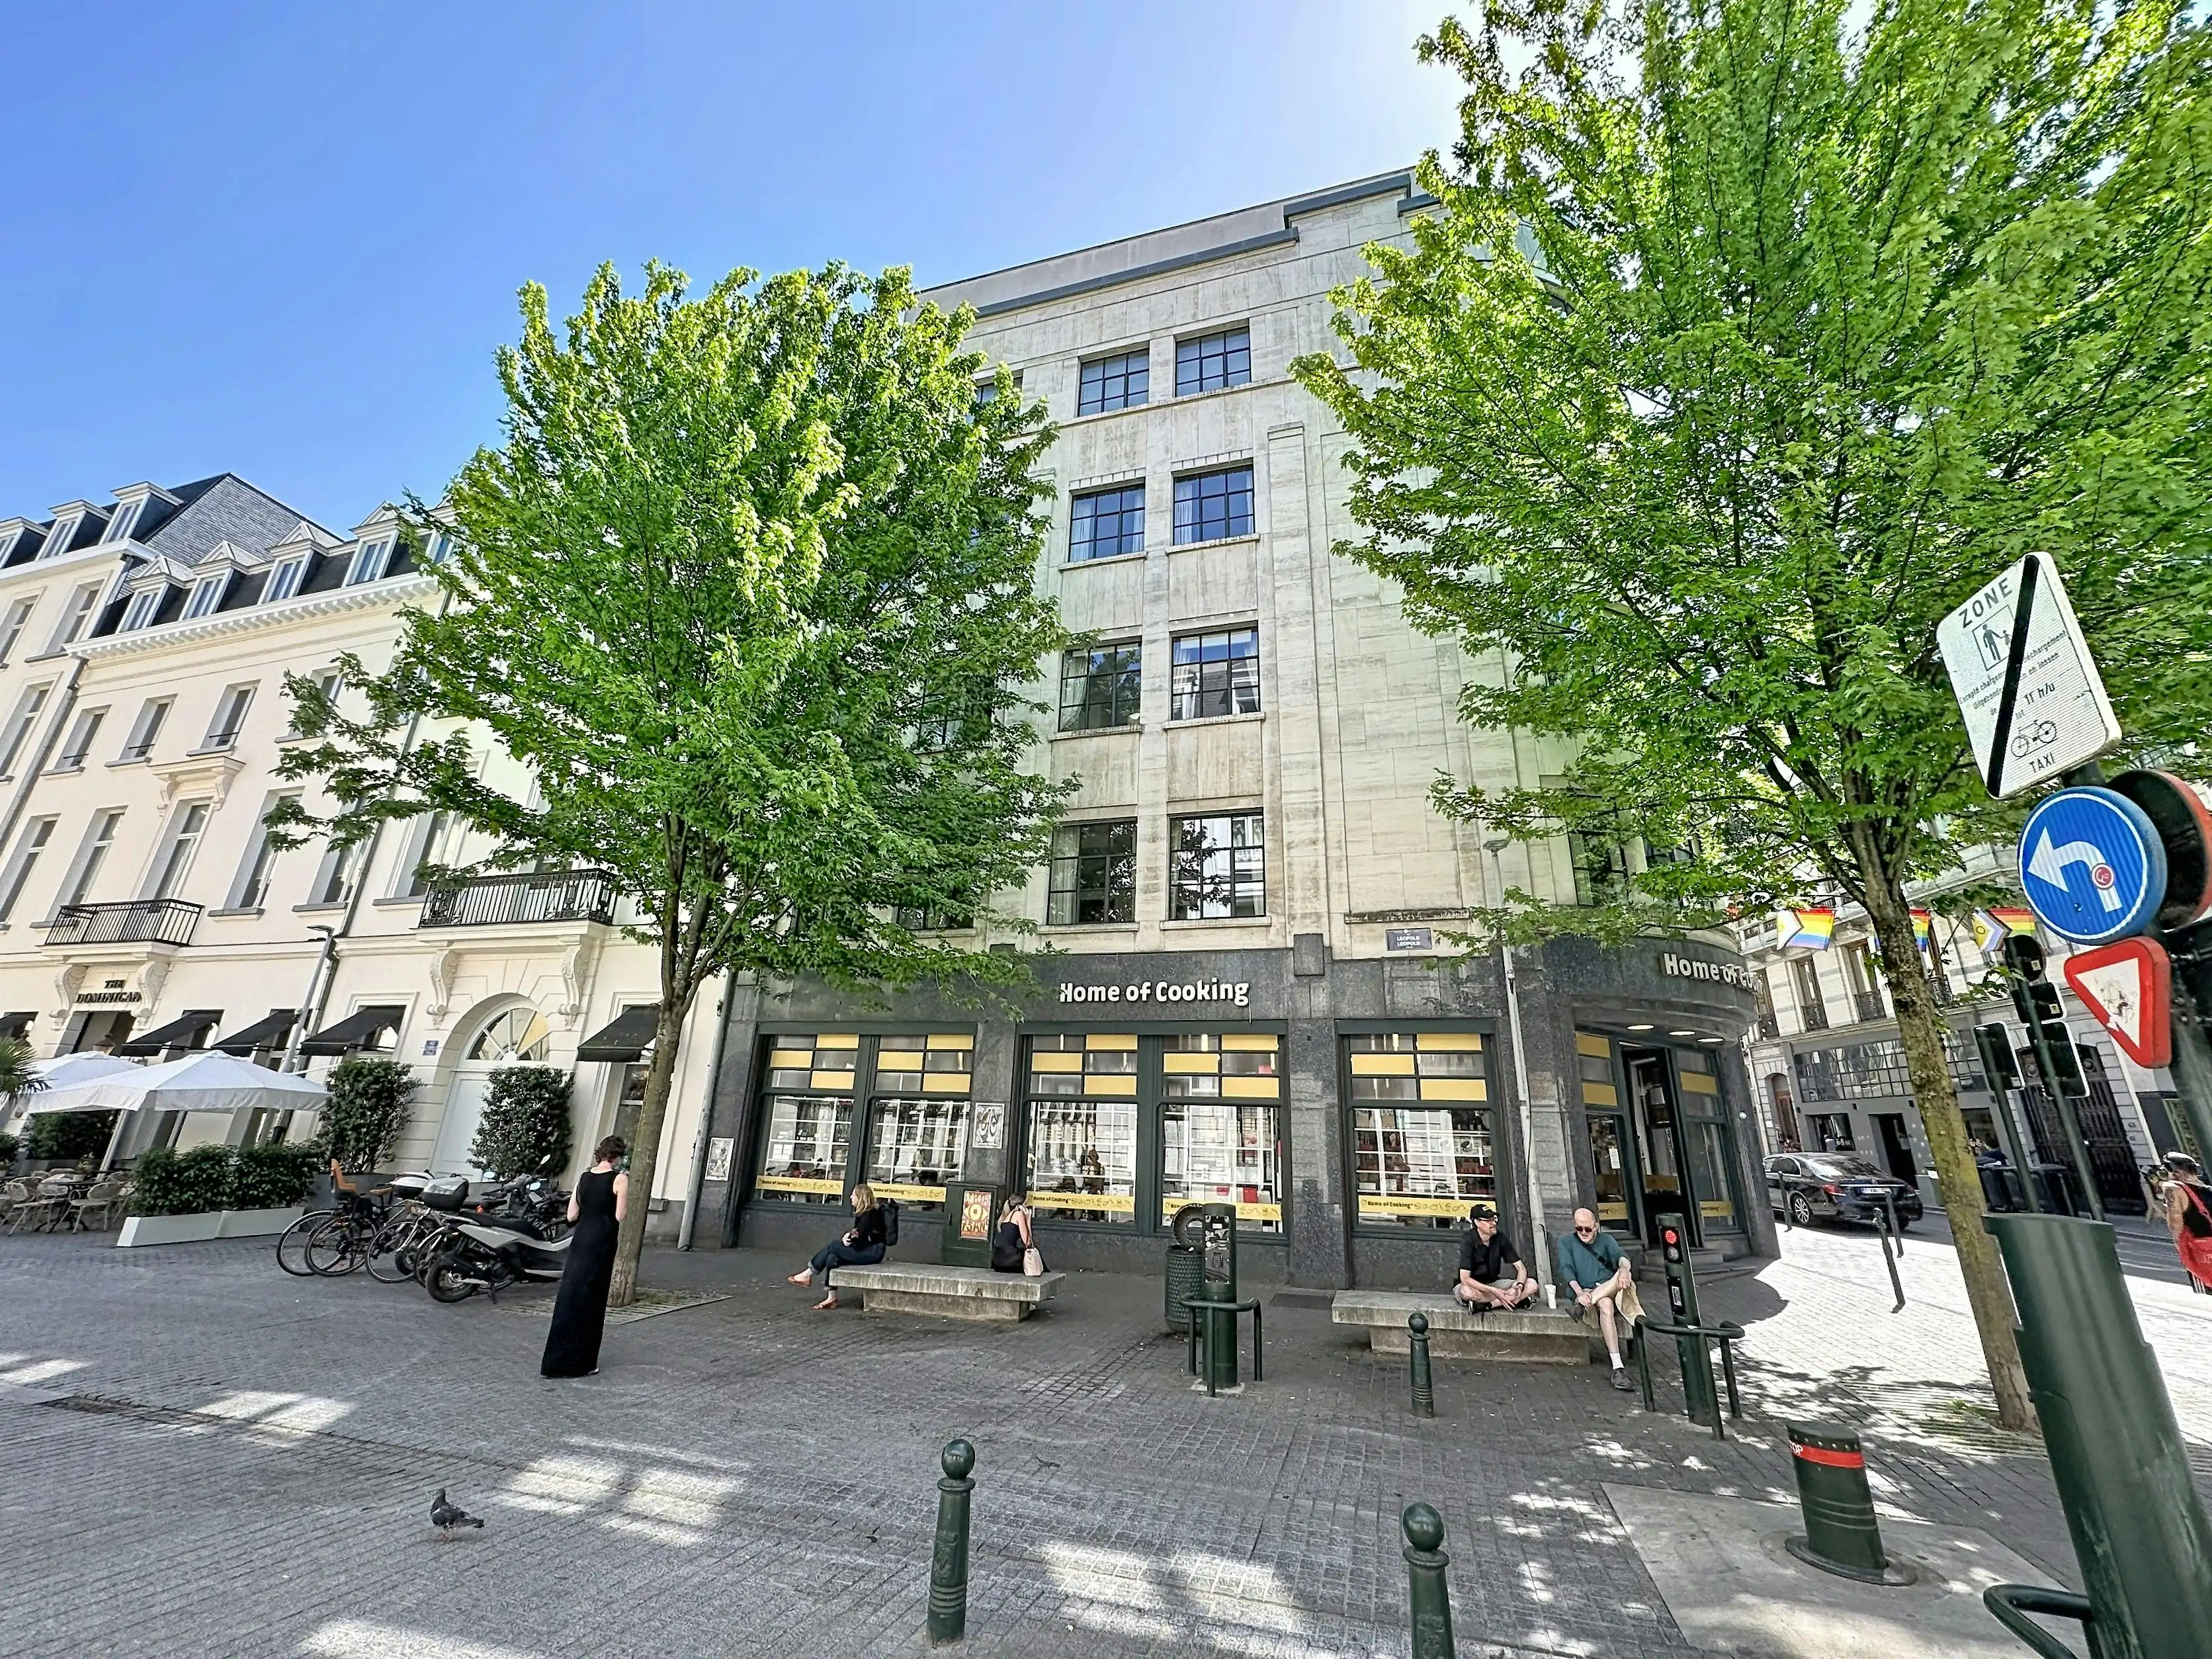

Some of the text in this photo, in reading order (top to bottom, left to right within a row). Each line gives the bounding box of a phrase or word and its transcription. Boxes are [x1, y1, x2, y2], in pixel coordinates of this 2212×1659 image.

[1958, 577, 2012, 628] ZONE
[2029, 751, 2056, 773] TAXI
[1663, 953, 1720, 981] Home
[75, 992, 143, 1003] DOMINICAN
[1060, 978, 1250, 1007] Home of Cooking
[1789, 1439, 1804, 1457] TOP
